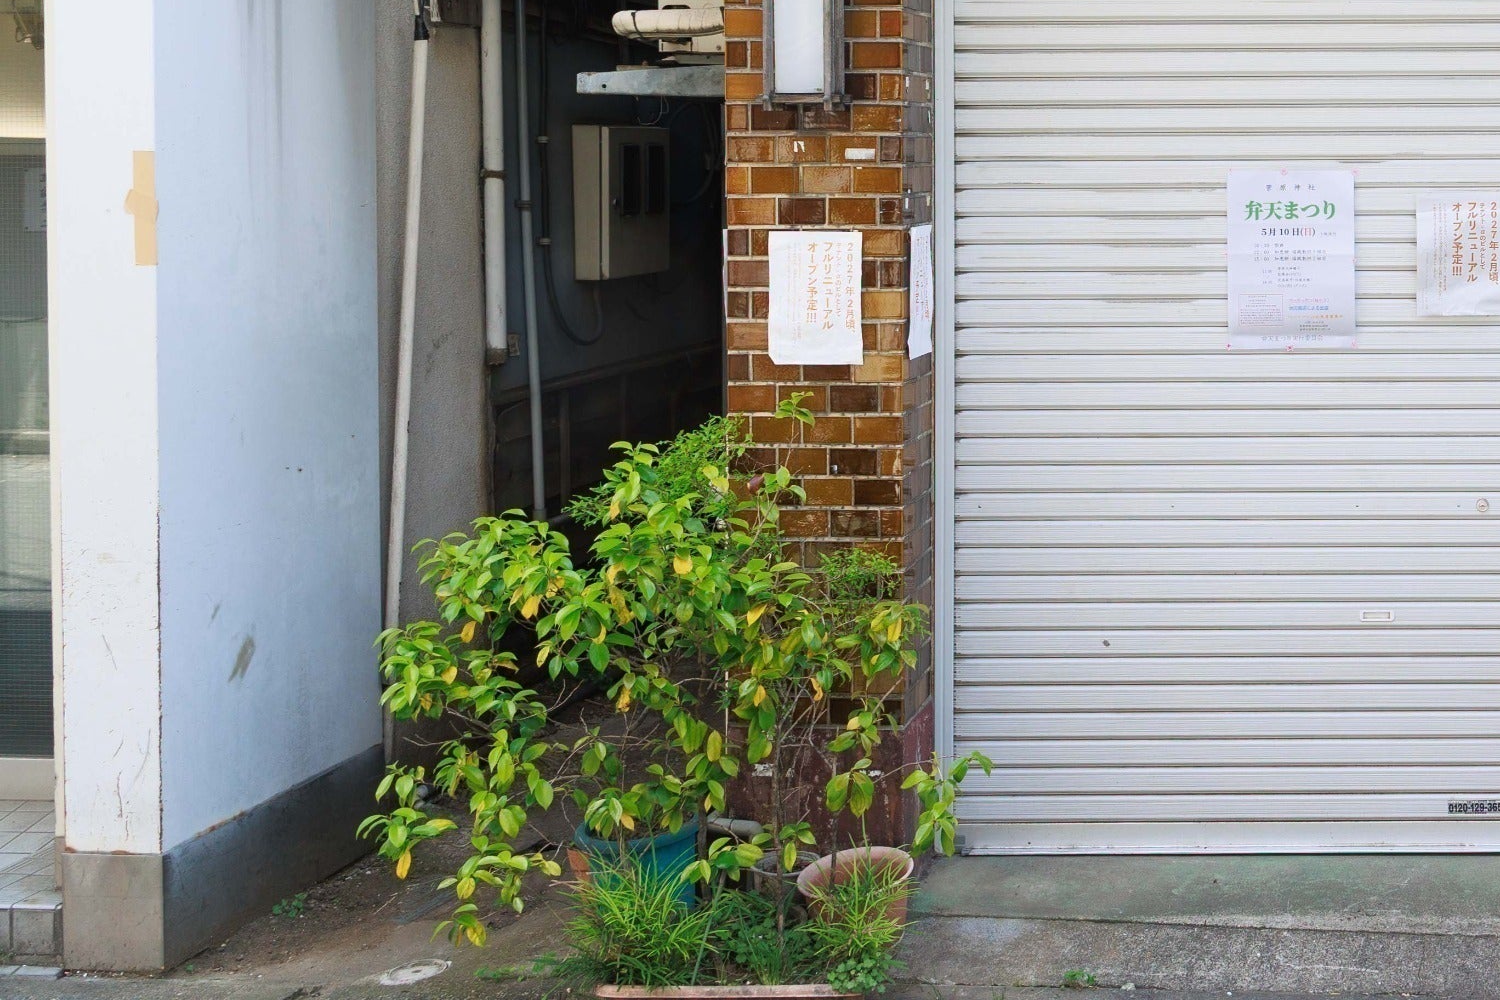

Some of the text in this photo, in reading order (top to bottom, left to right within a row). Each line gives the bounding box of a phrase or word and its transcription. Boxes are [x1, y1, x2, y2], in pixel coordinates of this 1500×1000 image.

[1244, 200, 1336, 220] 弁天まつり
[1466, 201, 1478, 282] フルリニューアル
